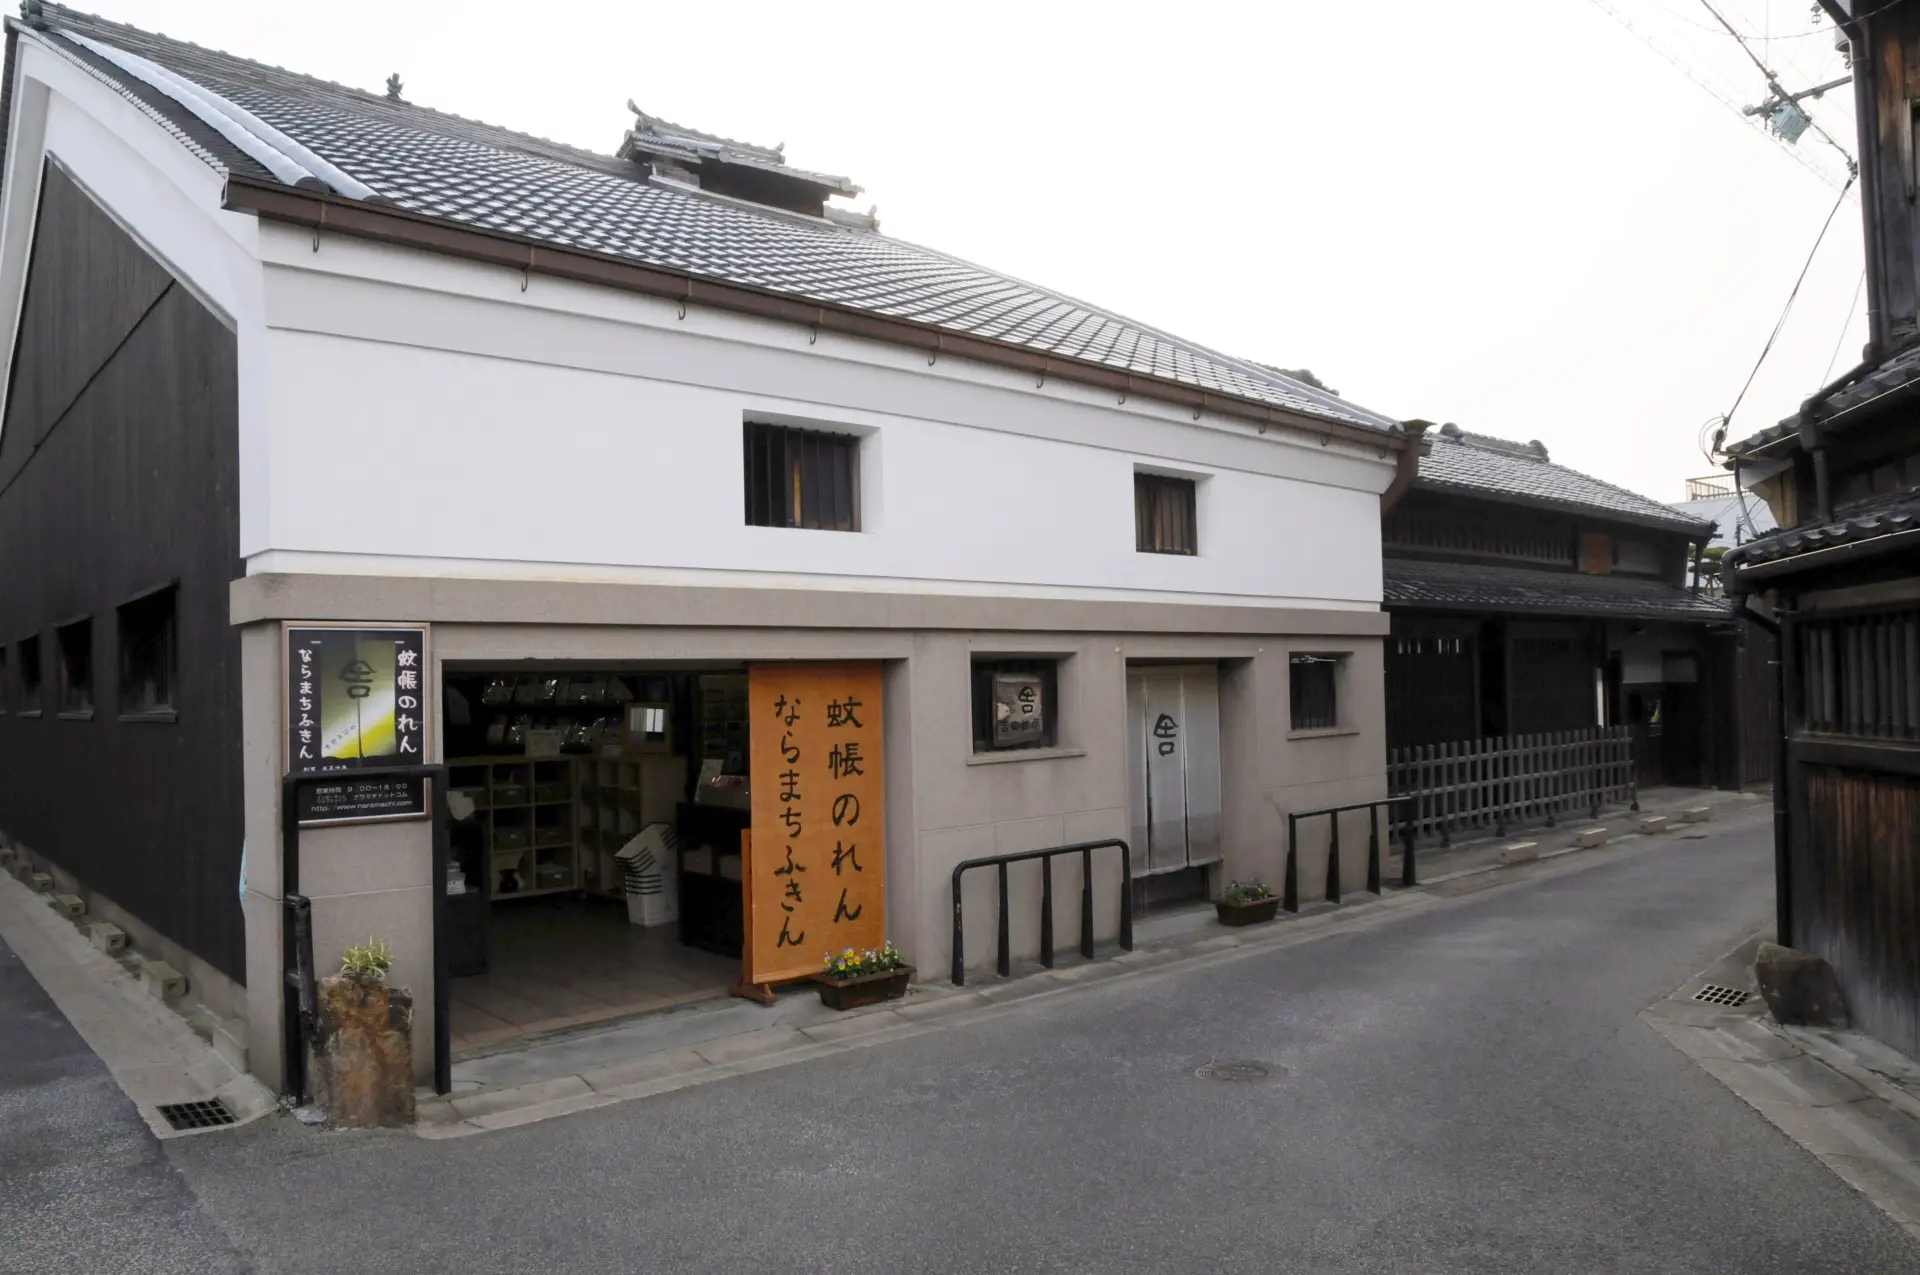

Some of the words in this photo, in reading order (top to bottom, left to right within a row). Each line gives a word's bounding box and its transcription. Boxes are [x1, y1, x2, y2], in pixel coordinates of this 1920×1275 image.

[298, 648, 314, 759] ならまちふきん
[397, 650, 418, 753] 蚊帳のれん
[773, 693, 806, 948] ならまちふきん
[826, 696, 864, 923] 蚊帳のれん
